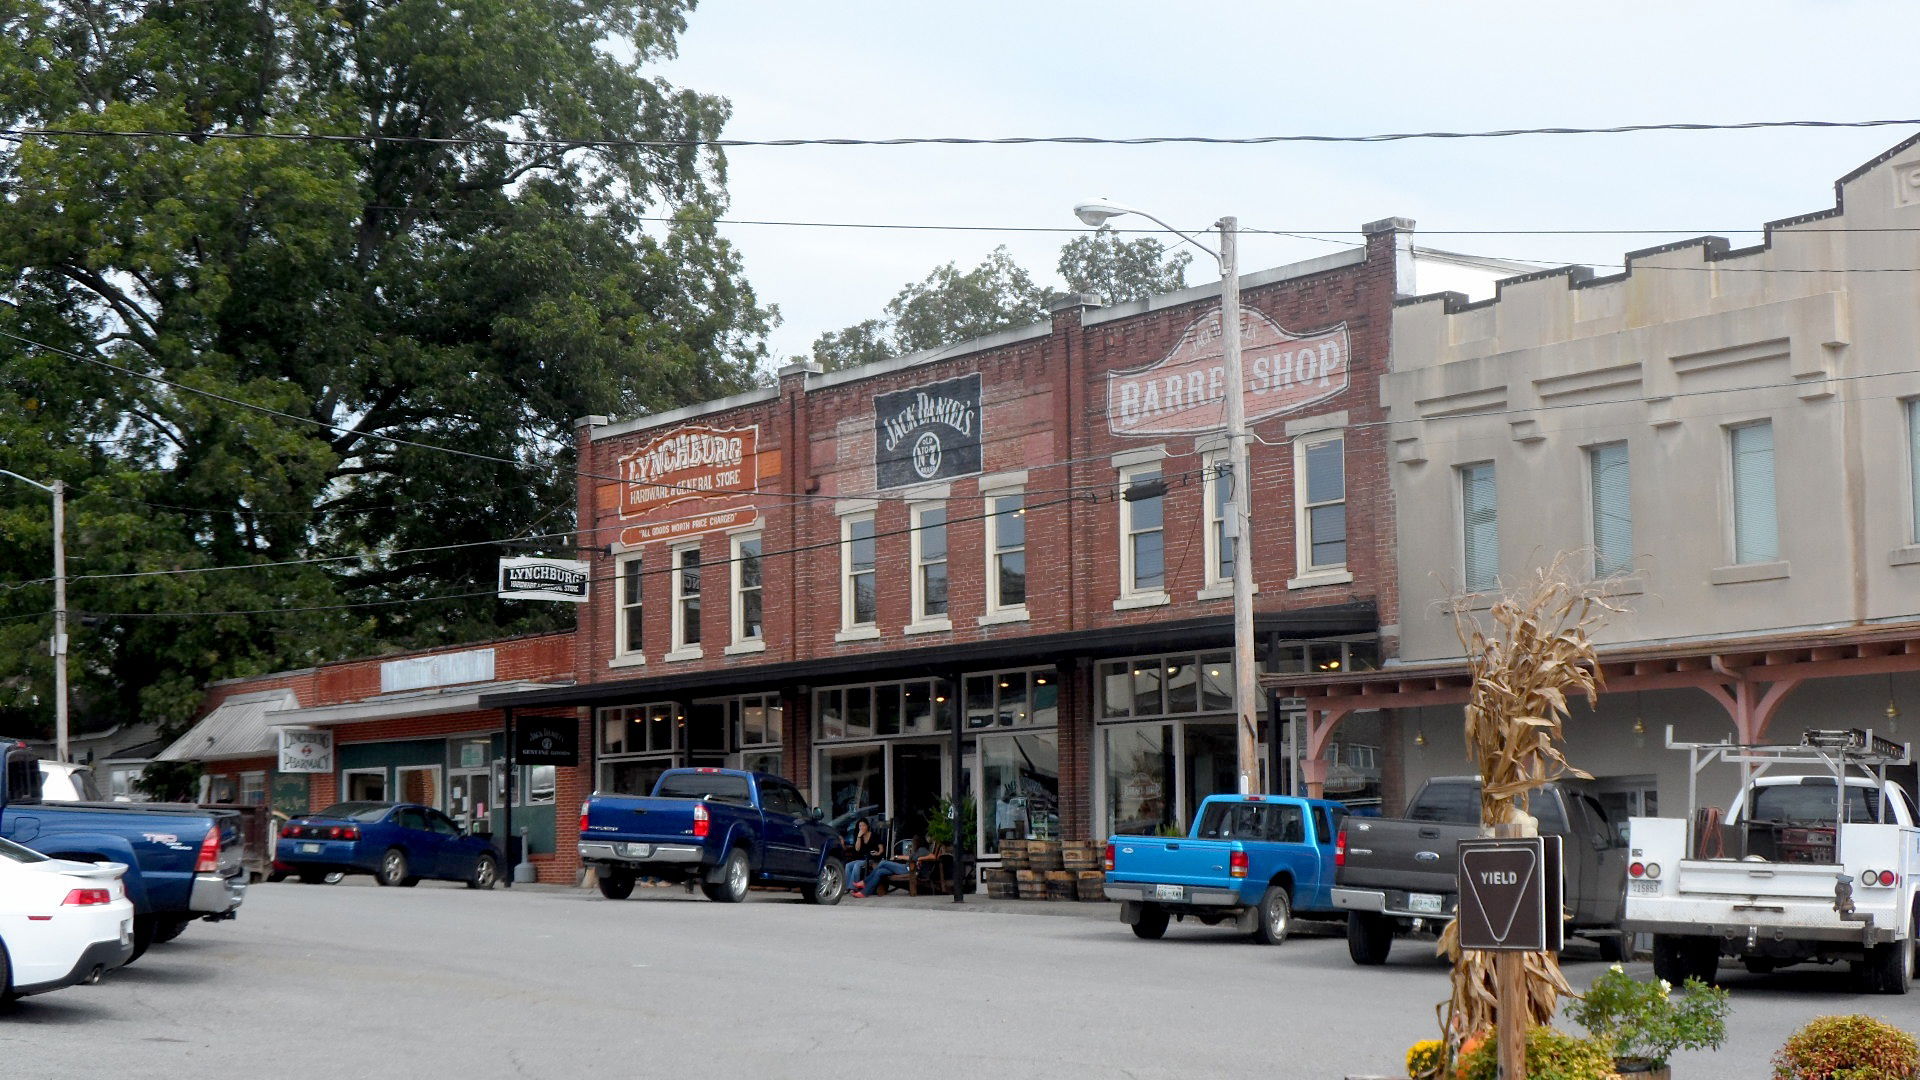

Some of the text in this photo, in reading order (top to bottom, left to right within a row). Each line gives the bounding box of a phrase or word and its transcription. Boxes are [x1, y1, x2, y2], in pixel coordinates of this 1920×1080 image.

[1119, 340, 1340, 427] BARRE SHOP
[883, 392, 975, 452] JACK DANIEL'S
[921, 437, 933, 445] OLD
[628, 433, 742, 489] LYNCHBURG
[630, 484, 670, 504] HARDWARE
[676, 474, 713, 498] GENERAL
[715, 469, 741, 488] STORE
[652, 523, 670, 537] GOODS
[671, 521, 690, 533] WORTH
[692, 517, 707, 529] PRICE
[509, 566, 580, 584] LYNCHBURG
[510, 580, 537, 589] HARDWARE
[283, 752, 331, 770] PHARMACY
[142, 832, 178, 844] TRD
[1481, 871, 1518, 885] YIELD
